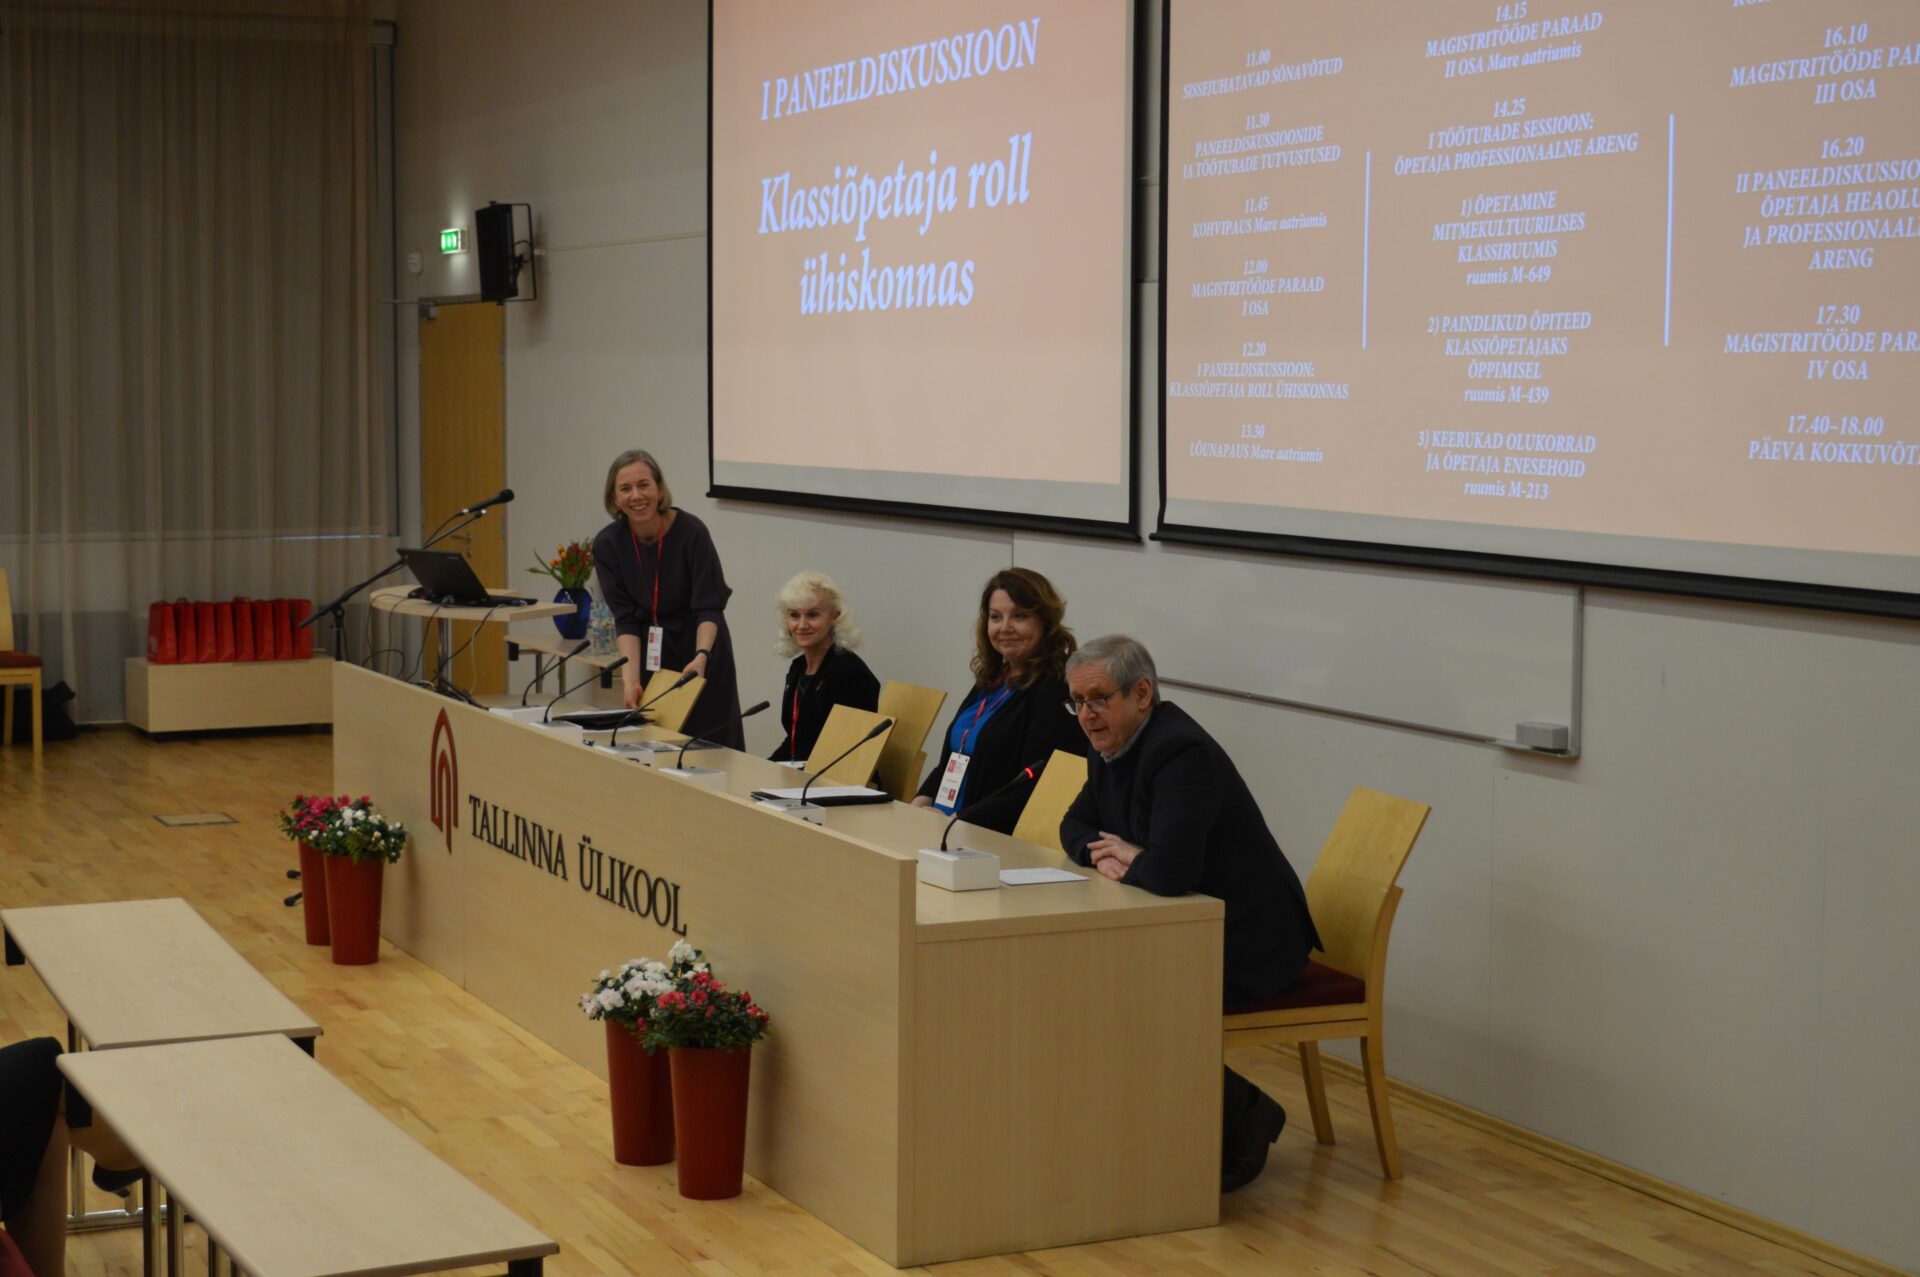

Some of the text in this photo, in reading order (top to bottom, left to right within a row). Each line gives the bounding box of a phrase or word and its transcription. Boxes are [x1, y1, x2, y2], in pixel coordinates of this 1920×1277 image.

[1495, 1, 1527, 23] 14.15
[1425, 11, 1604, 58] MAGISTRITÖÖDE PARAAD
[1823, 22, 1868, 48] 16.10
[760, 18, 1040, 121] I PANEELDISKUSSIOON
[1246, 49, 1271, 68] 11.00
[1444, 40, 1582, 78] II OSA Mare aatriumis
[1729, 48, 1883, 88] MAGISTRITÖÖDE
[1183, 57, 1344, 99] SISSEJUHATAVAD SÕNAVÕTUD
[1814, 78, 1877, 104] III OSA
[1493, 98, 1526, 118] 14.25
[1245, 112, 1271, 130] 11.30
[1427, 112, 1594, 150] I TÖÖTUBADE SESSIOON:
[1194, 125, 1325, 157] PANEELDISKUSSIOONIDE
[1821, 136, 1865, 159] 16.20
[1182, 145, 1342, 181] JA TÖÖTUBADE TUTVUSTUSED
[1394, 132, 1639, 176] ÕPETAJA PROFESSIONAALNE ARENG
[758, 132, 1032, 242] Klassiõpetaja roll
[1735, 173, 1749, 193] II
[1460, 190, 1557, 218] 1) ÕPETAMINE
[1760, 194, 1840, 218] ÕPETAJA
[1192, 218, 1252, 238] KOHVIPAUS
[1432, 212, 1586, 241] MITMEKULTUURILISES
[1743, 216, 1920, 249] JA PROFESSIONAAL
[1457, 240, 1558, 263] KLASSIRUUMIS
[1809, 247, 1874, 270] ARENG
[1243, 259, 1268, 275] 12.00
[1466, 264, 1551, 285] ruumis M-649
[800, 248, 975, 315] ühiskonnas
[1191, 276, 1325, 298] MAGISTRITÖÖDE PARAAD
[1249, 300, 1269, 316] OSA
[1816, 305, 1861, 325] 17.30
[1427, 310, 1592, 336] 2) PAINDLIKUD ÕPITEED
[1242, 342, 1267, 357] 12.20
[1444, 335, 1568, 358] KLASSIÕPETAJAKS
[1723, 328, 1920, 353] MAGISTRITÖÖDE PAR
[1467, 359, 1542, 379] ÕPPIMISEL
[1807, 360, 1869, 380] IV OSA
[1169, 380, 1349, 399] KLASSIÕPETAJA ROLL ÜHISKONNAS
[1464, 385, 1550, 404] ruumis M-439
[1240, 424, 1265, 439] 13.30
[1417, 430, 1596, 454] 3) KEERUKAD OLUKORRAD
[1189, 440, 1249, 458] LÕUNAPAUS
[1748, 436, 1920, 465] PÄEVA KOKKUVÕT
[1426, 451, 1586, 477] JA ÕPETAJA ENESEHOID
[1464, 479, 1549, 500] ruumis M-213
[468, 794, 687, 936] TALLINNA ÜLIKOOL
